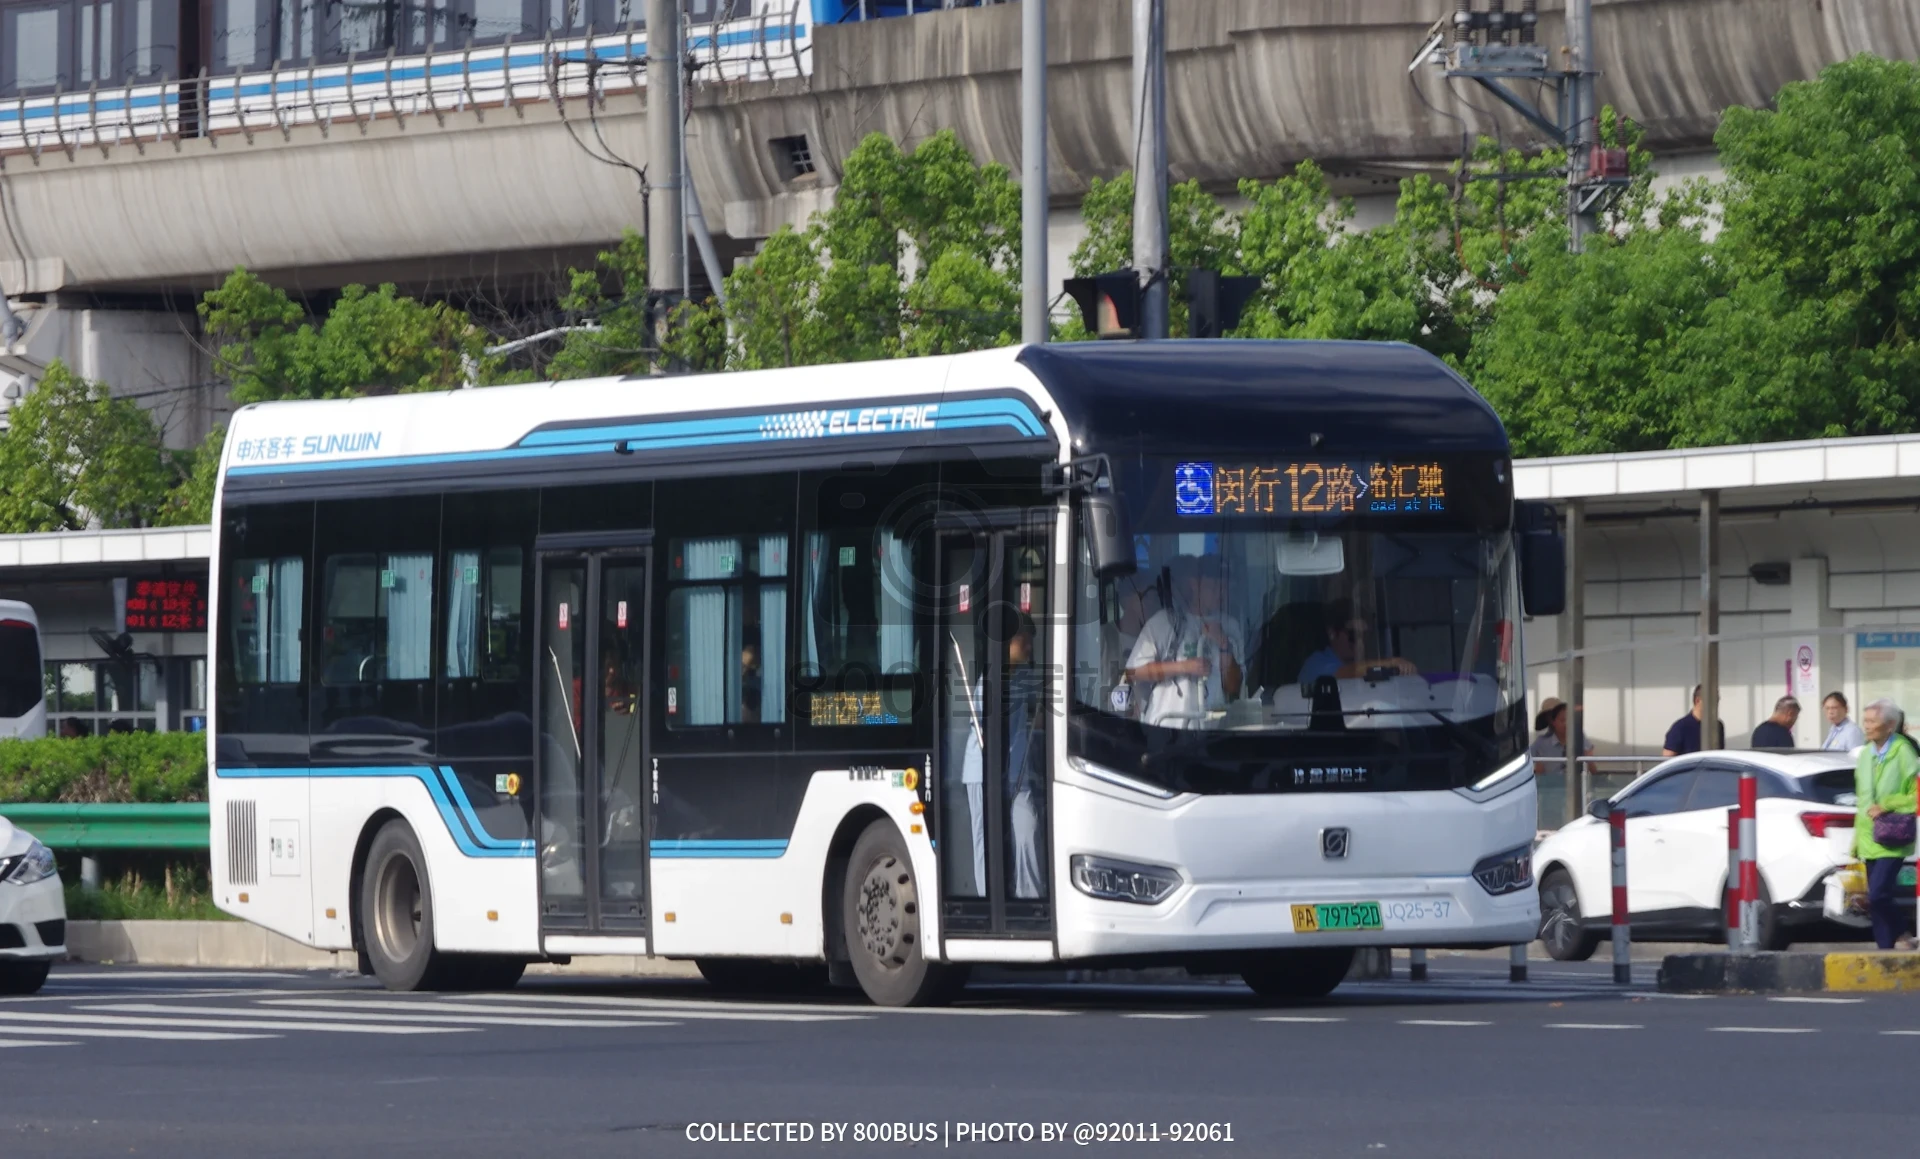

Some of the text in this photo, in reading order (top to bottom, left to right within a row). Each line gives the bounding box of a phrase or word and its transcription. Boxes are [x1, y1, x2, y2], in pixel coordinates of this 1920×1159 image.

[829, 405, 939, 434] ELECTRIC
[236, 431, 382, 461] 申沃客车 SUNWIN
[1215, 463, 1356, 513] 闵行12路
[1385, 901, 1451, 921] JQ25-37
